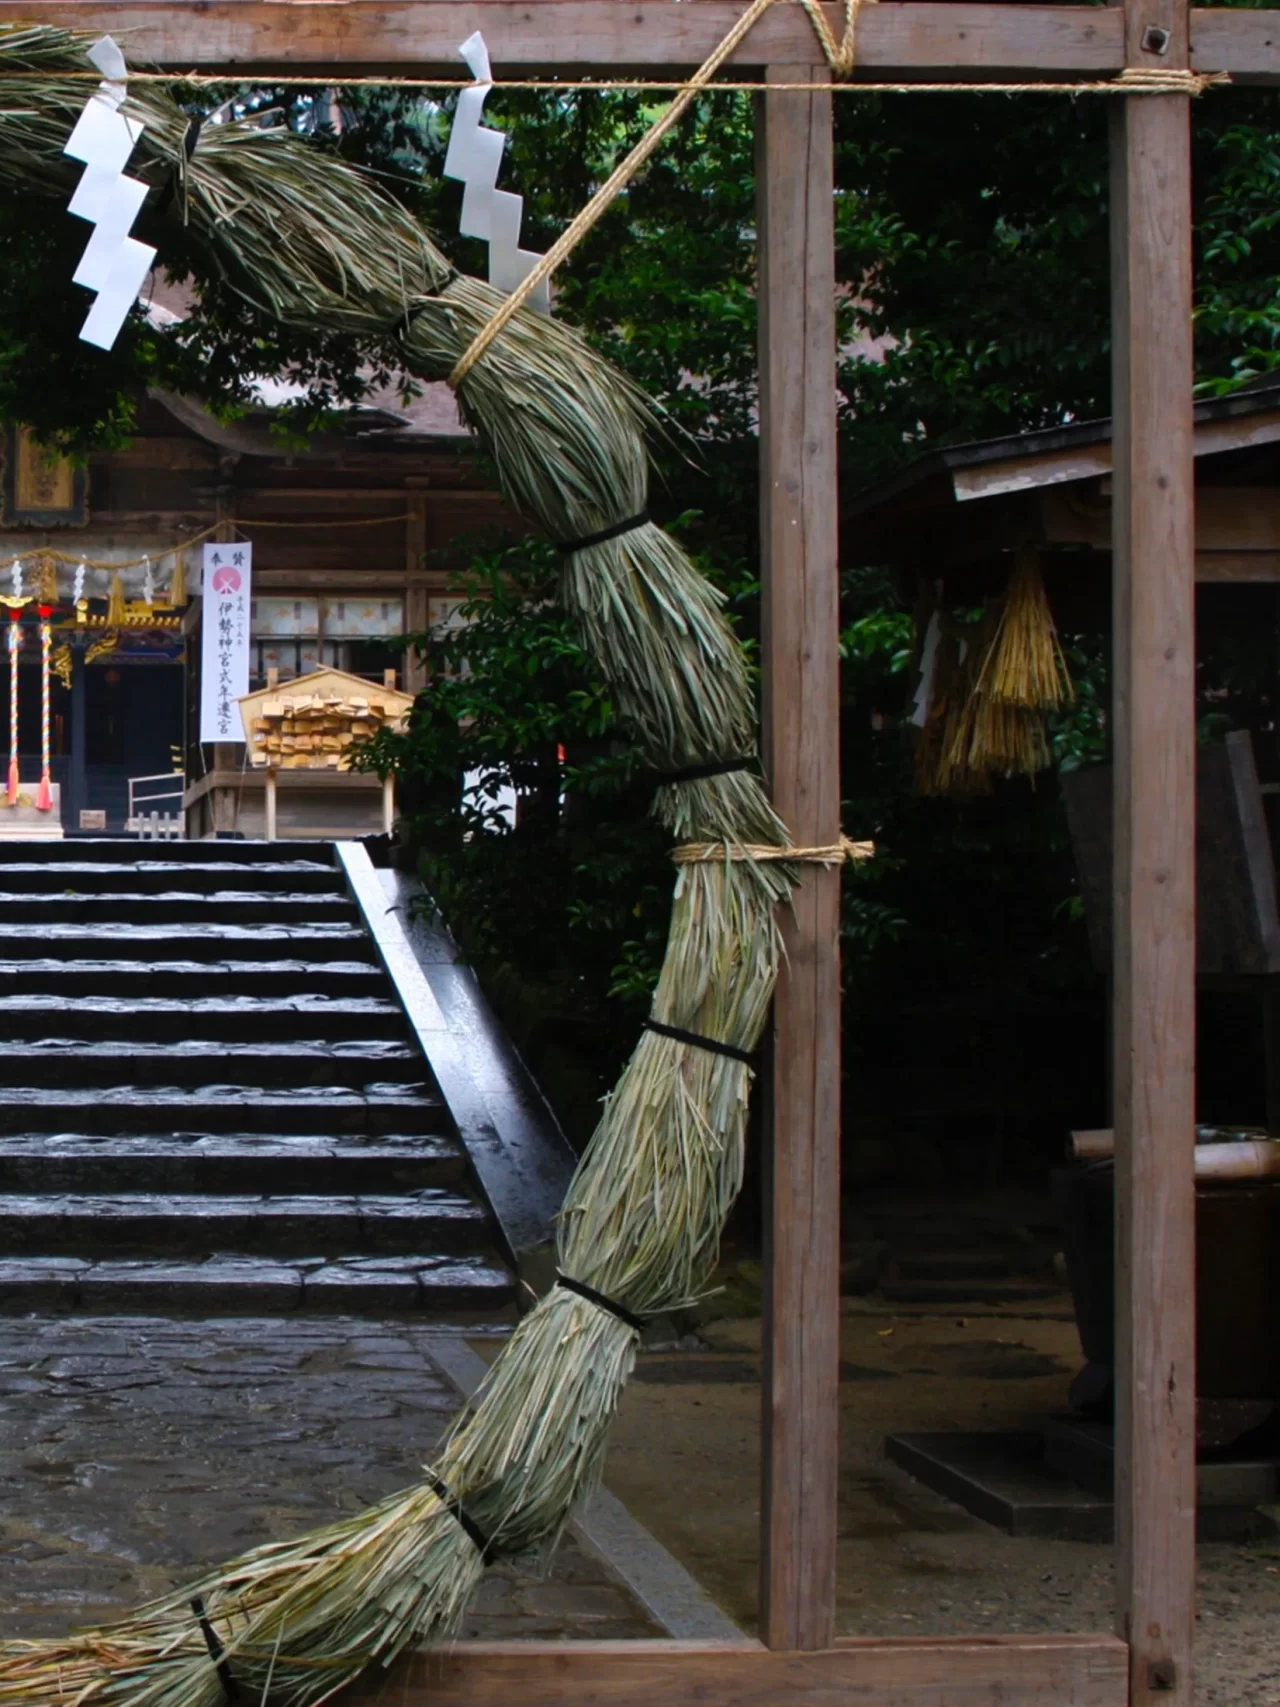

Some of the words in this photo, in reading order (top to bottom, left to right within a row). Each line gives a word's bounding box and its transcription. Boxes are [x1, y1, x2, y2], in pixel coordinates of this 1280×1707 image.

[217, 601, 233, 734] 伊勢神宮式年遷宮
